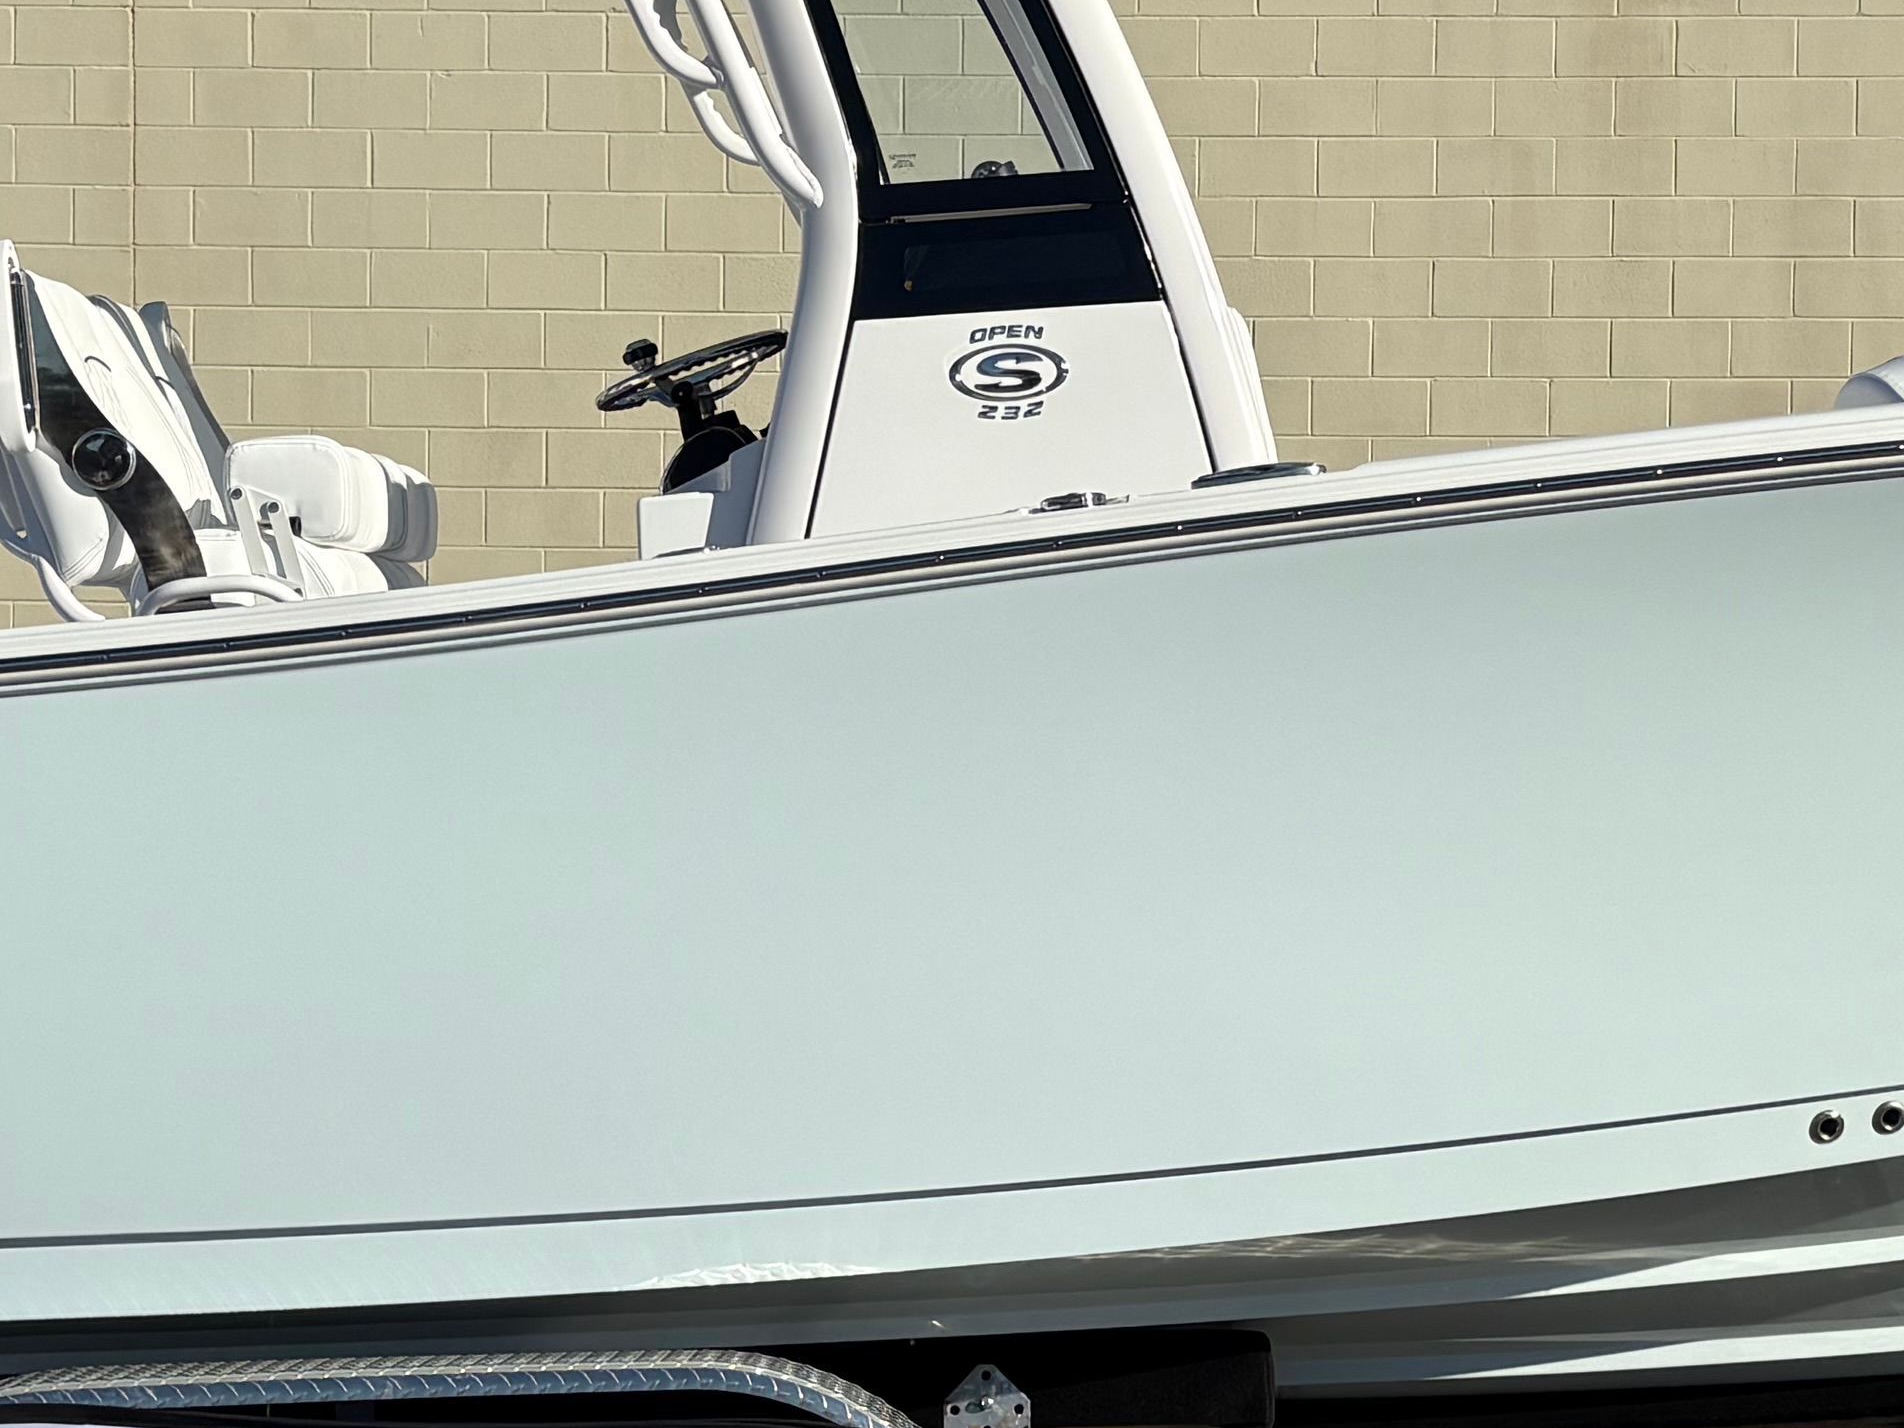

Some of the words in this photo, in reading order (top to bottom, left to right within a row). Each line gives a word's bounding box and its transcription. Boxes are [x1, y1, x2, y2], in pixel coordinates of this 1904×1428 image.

[969, 324, 1044, 344] OPEN
[974, 352, 1043, 393] S
[977, 400, 1044, 420] 232
